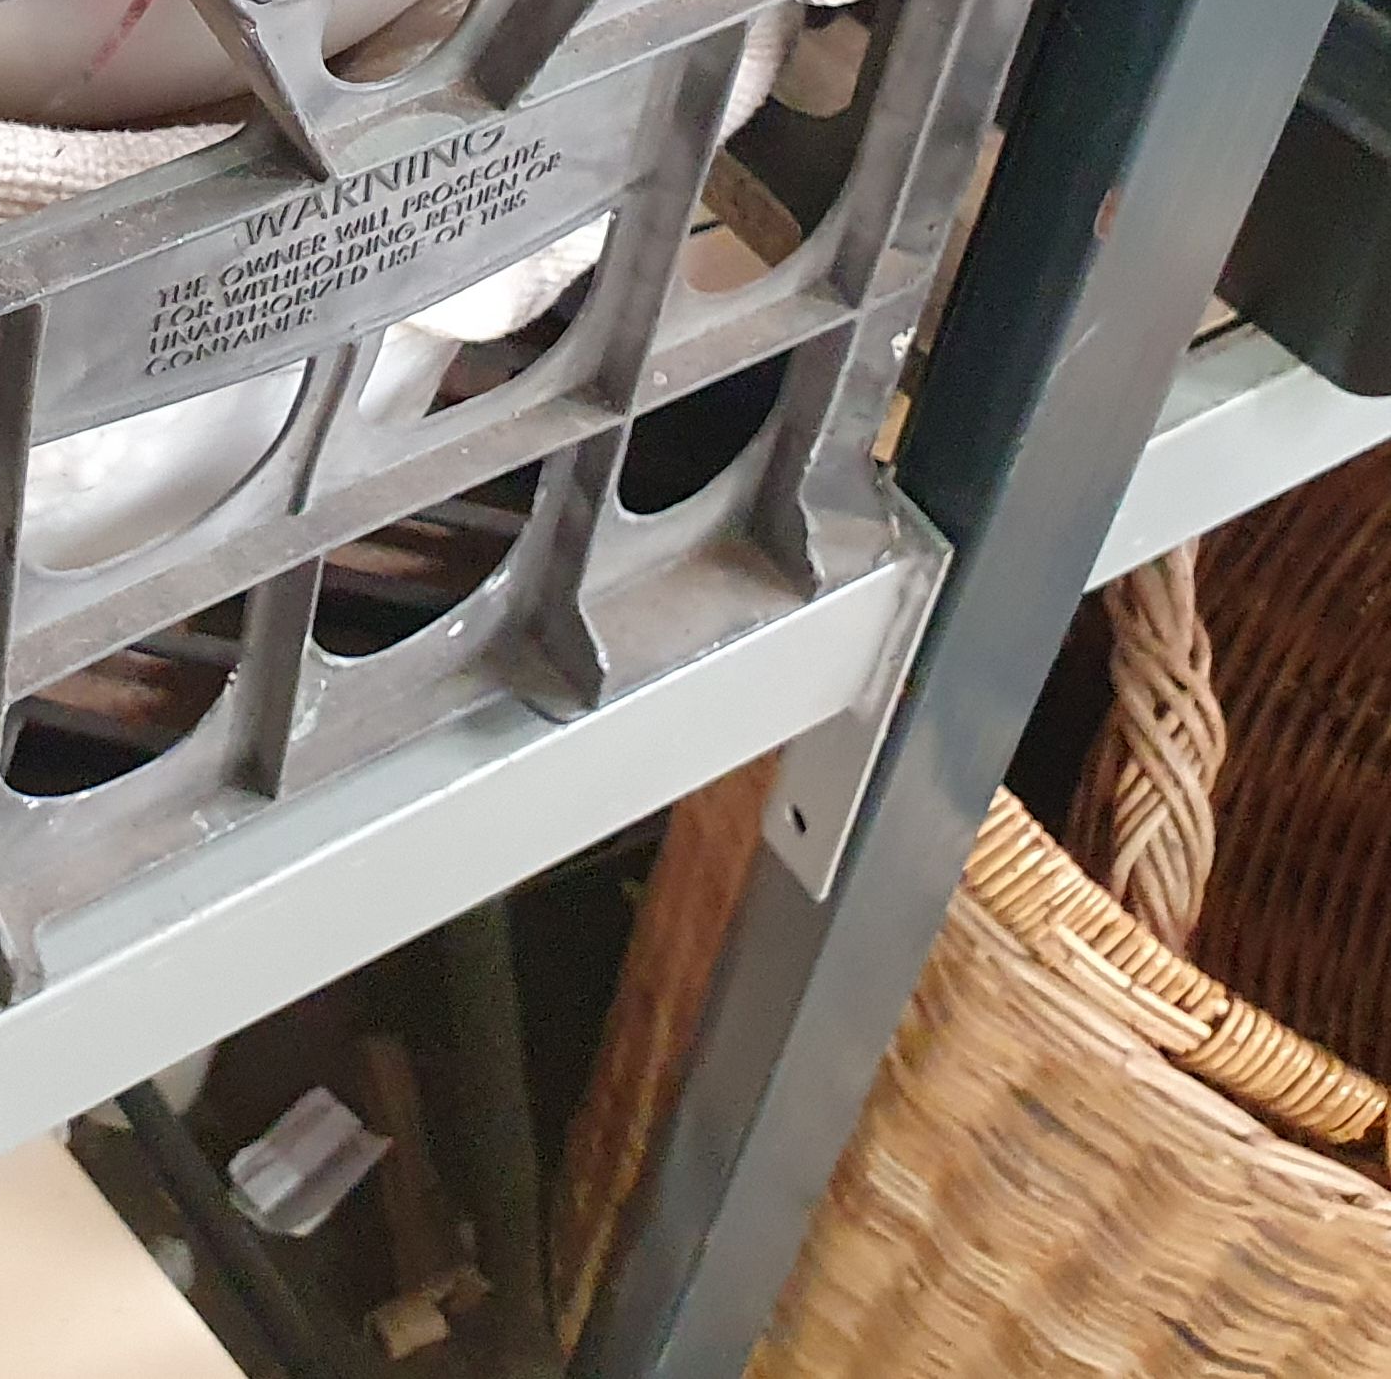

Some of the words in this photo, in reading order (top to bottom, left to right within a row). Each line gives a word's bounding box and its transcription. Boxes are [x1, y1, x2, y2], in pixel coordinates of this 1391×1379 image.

[152, 299, 214, 333] FOR
[223, 221, 416, 308] WITHHOLDING
[424, 172, 519, 231] RETURN
[525, 151, 561, 182] OR
[158, 273, 210, 308] THE
[218, 232, 327, 287] OWNER
[334, 207, 389, 245] WILL
[401, 138, 547, 219] PROSECUTE
[233, 124, 506, 247] WARNING
[150, 264, 368, 354] UNAUTHORIZED
[378, 239, 425, 272] USE
[435, 216, 472, 245] OF
[480, 188, 530, 226] THIS
